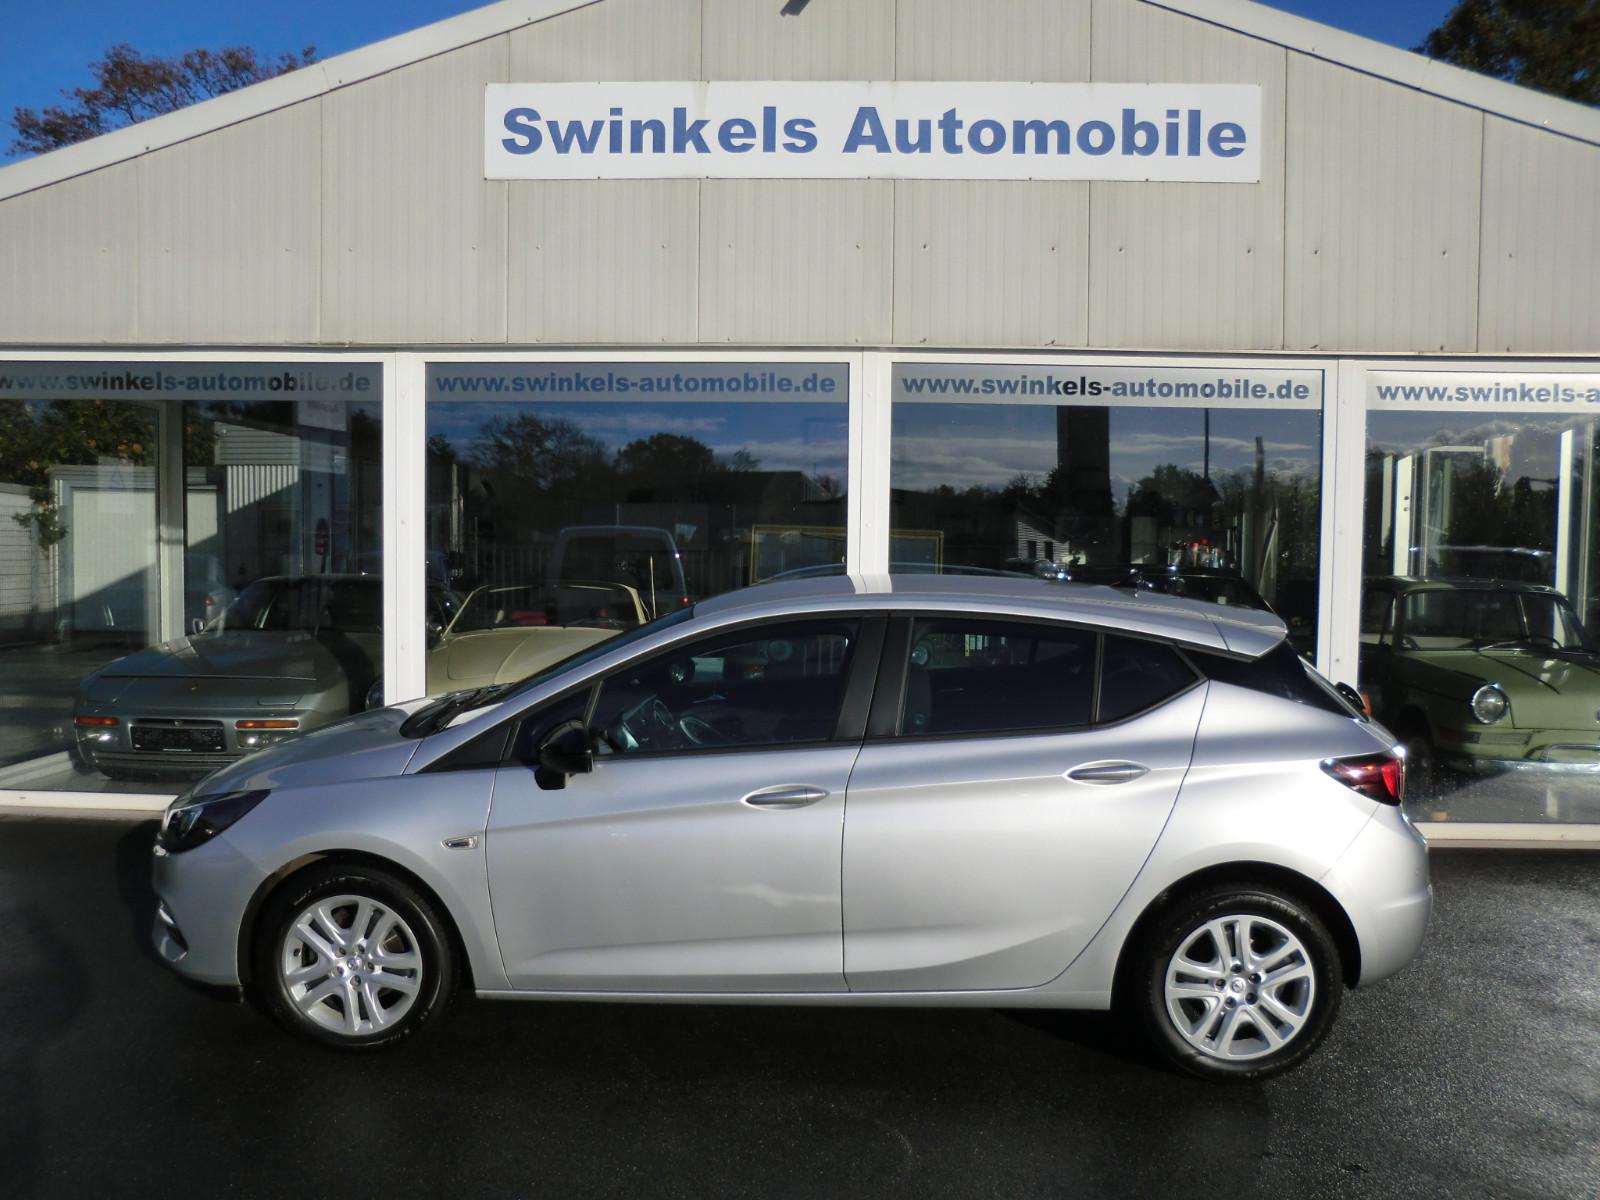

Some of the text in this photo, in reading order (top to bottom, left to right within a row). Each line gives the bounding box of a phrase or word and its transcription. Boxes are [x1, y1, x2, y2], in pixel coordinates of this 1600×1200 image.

[502, 106, 1246, 158] Swinkels Automobile
[436, 372, 836, 393] www.swinkels-automobile.de
[902, 375, 1309, 400] www.swinkels-automobile.de
[1377, 382, 1600, 403] www.swinkels-a
